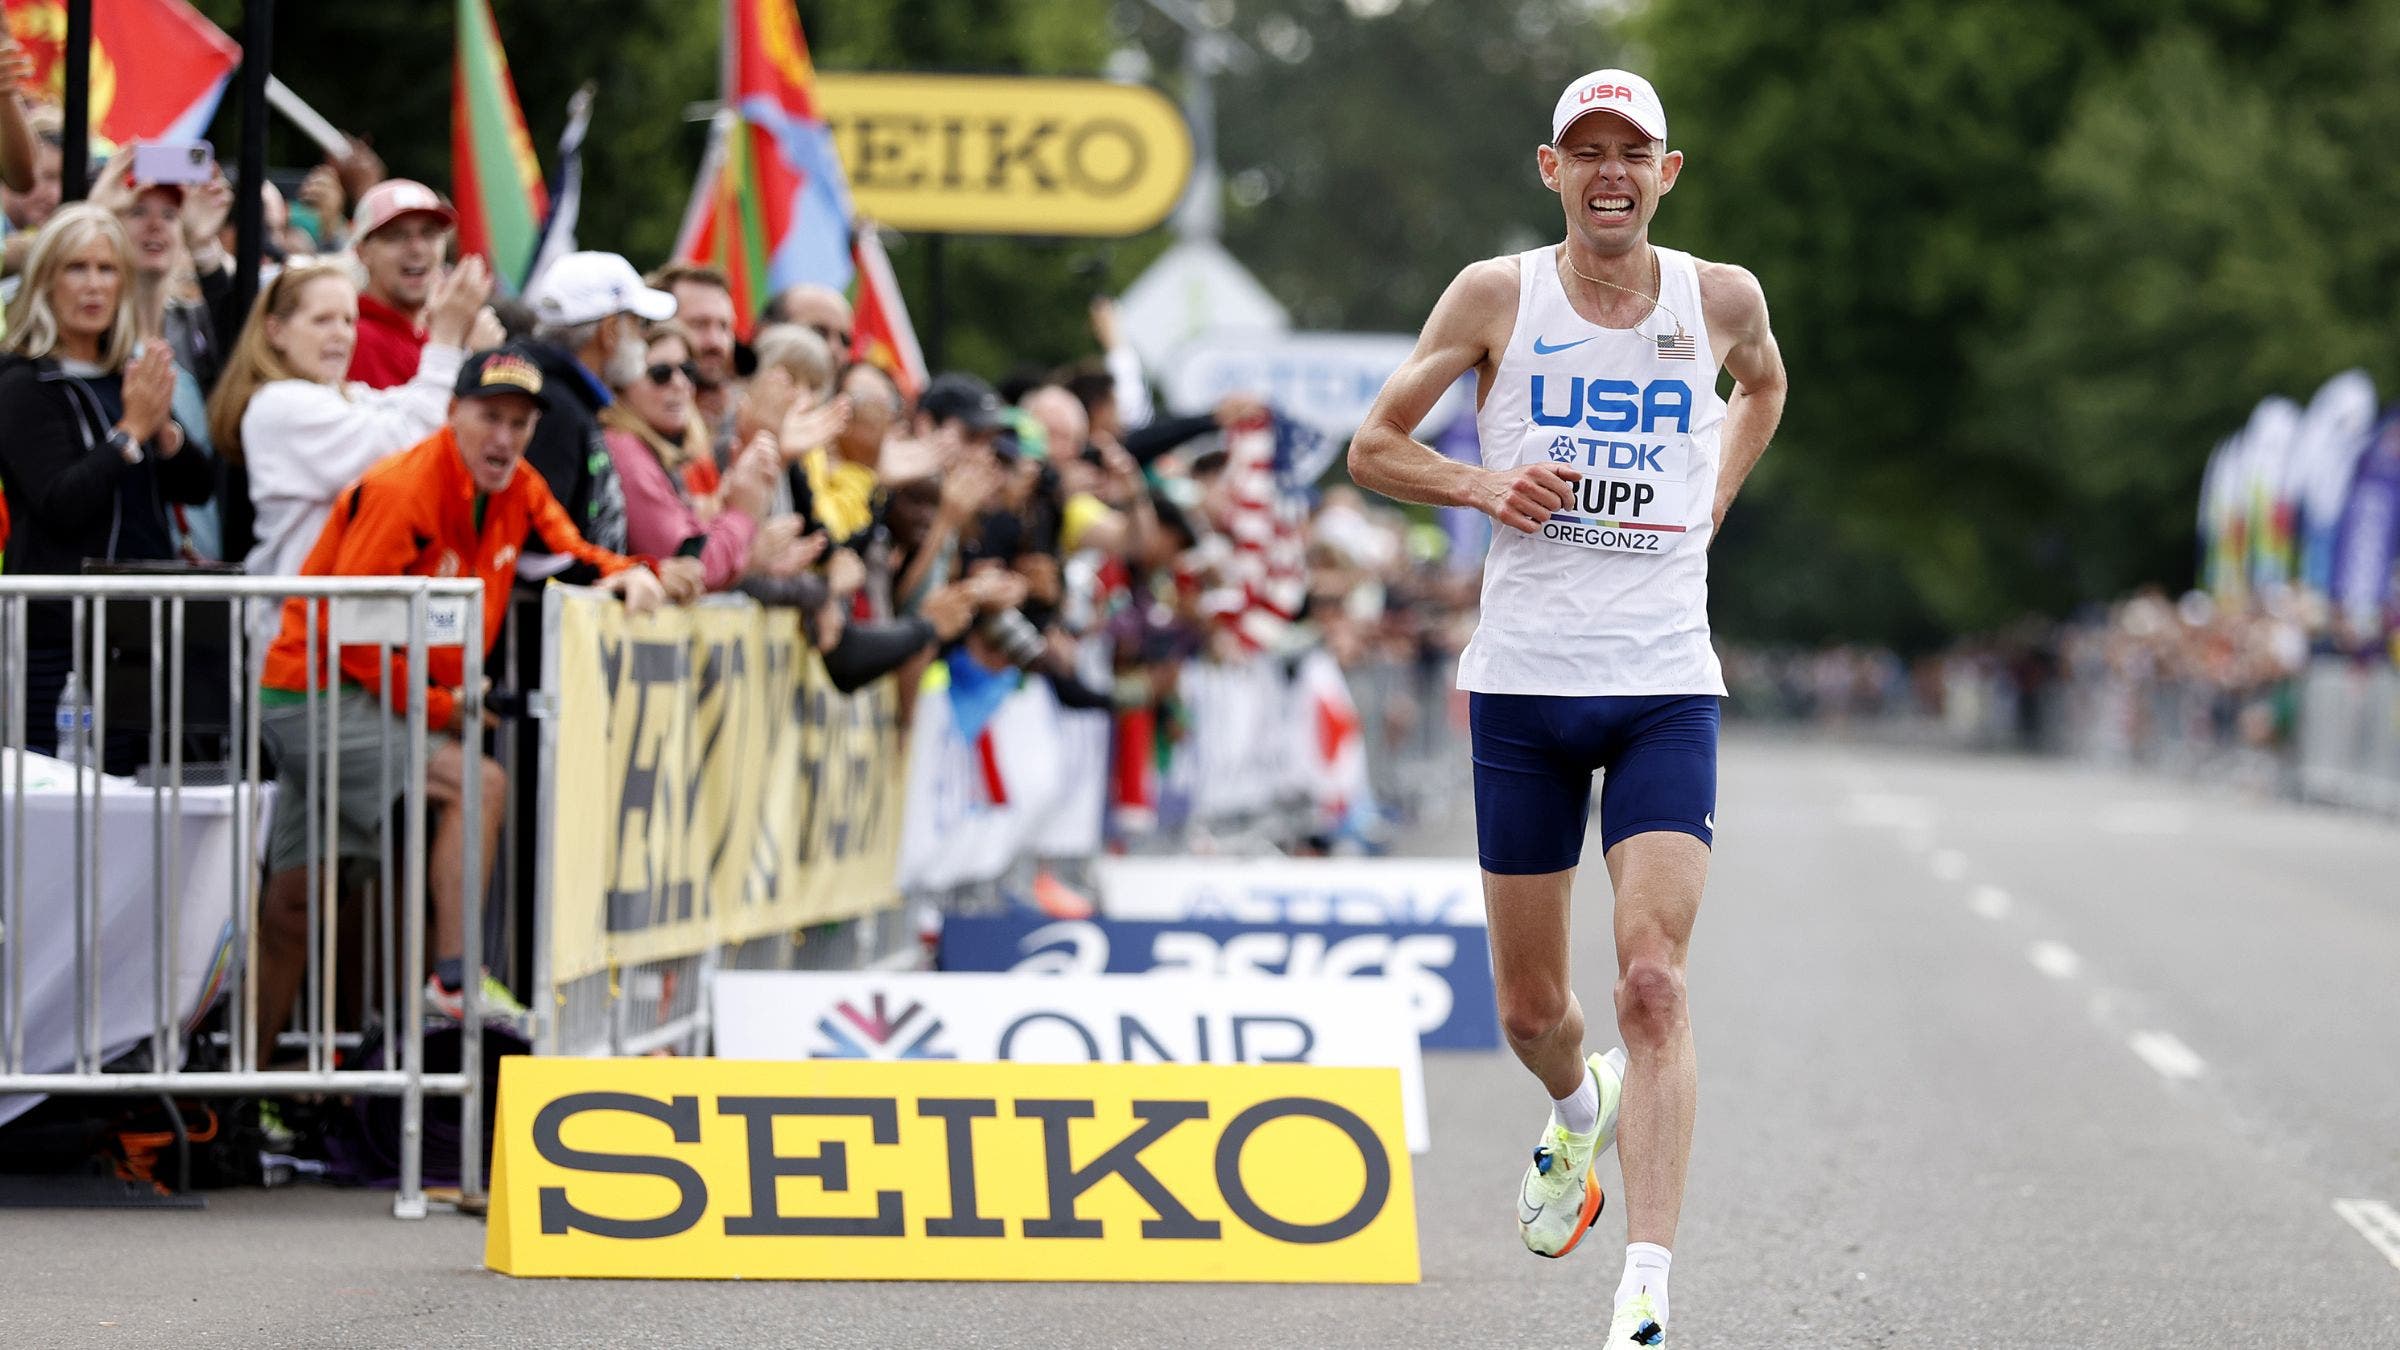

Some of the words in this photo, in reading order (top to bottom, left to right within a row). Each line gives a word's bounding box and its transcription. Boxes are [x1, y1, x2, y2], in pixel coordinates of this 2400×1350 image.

[1579, 84, 1632, 104] USA
[828, 114, 1149, 198] EIKO
[1531, 375, 1692, 434] USA
[1578, 438, 1665, 472] TDK
[1543, 523, 1659, 550] OREGON22
[530, 1091, 1391, 1245] SEIKO
